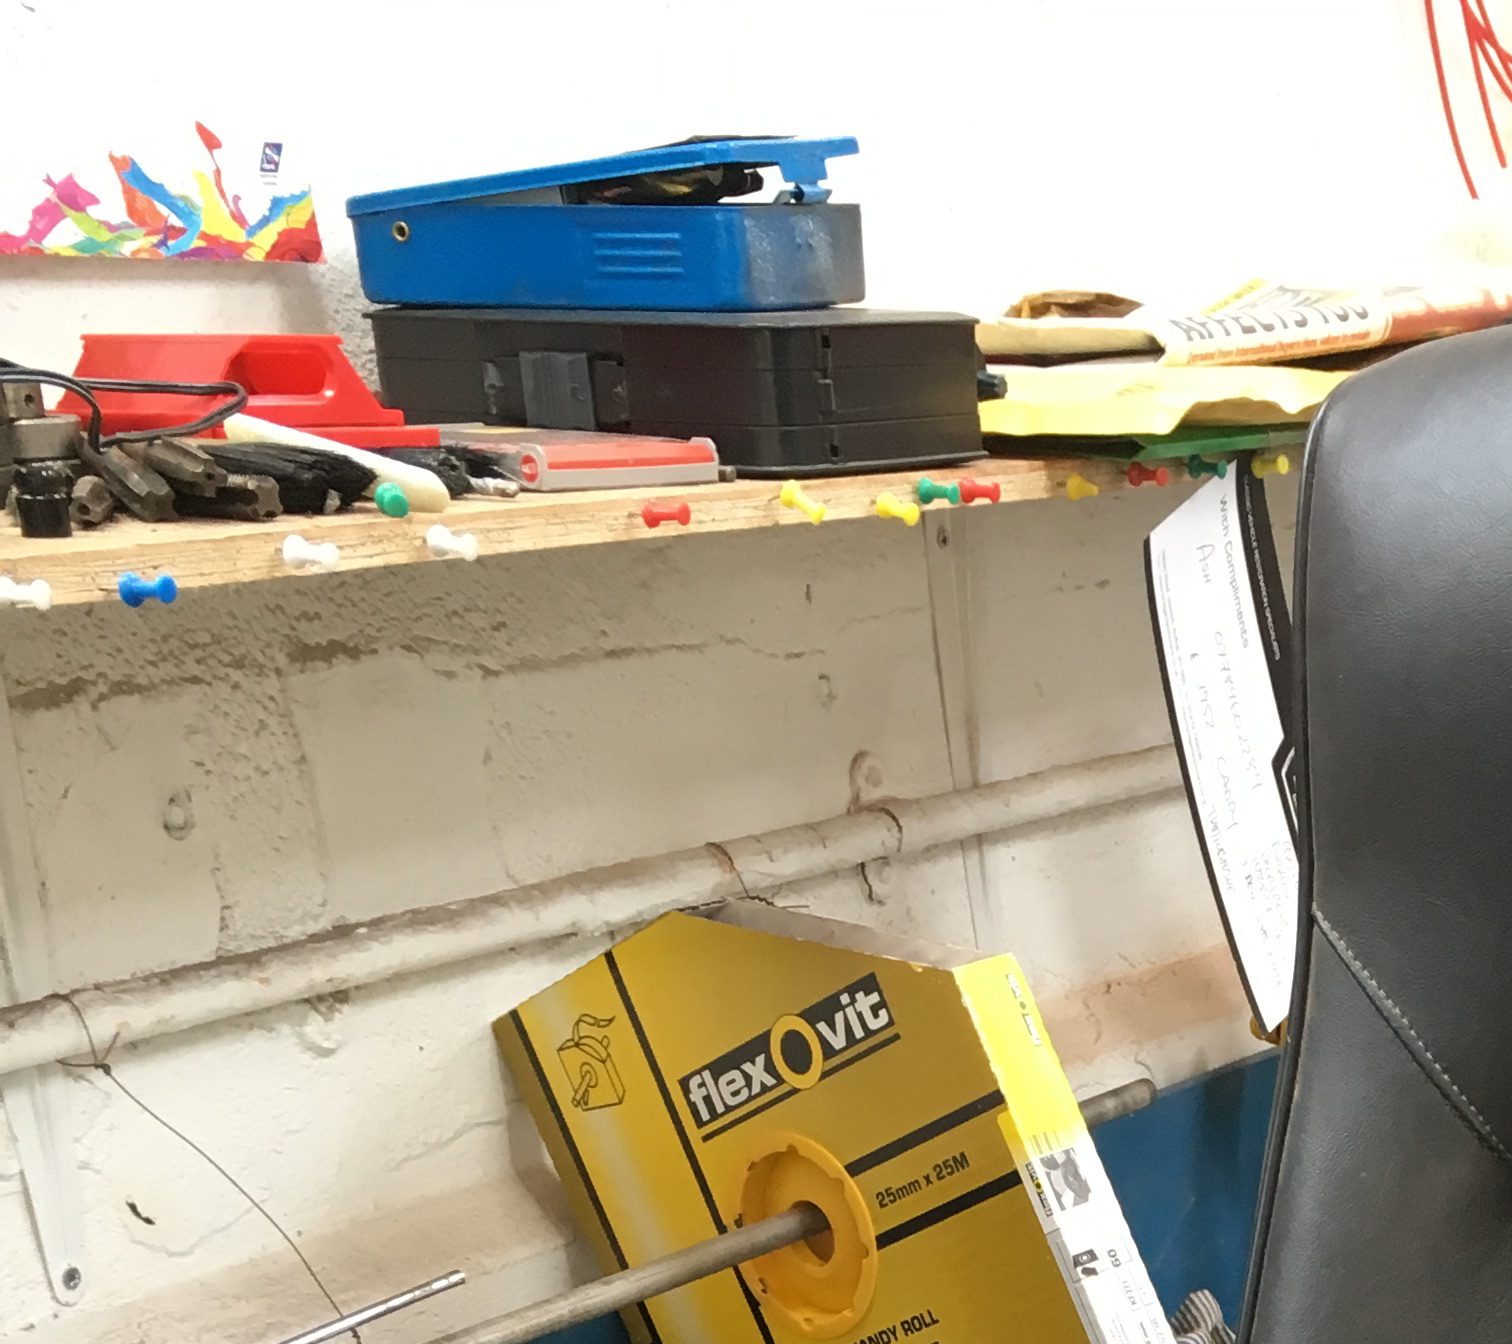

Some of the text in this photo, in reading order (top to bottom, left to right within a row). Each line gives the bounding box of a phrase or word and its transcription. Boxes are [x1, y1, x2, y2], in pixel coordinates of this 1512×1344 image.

[1219, 493, 1249, 649] With Compliments
[875, 1150, 970, 1209] 25mm x 25M
[901, 1309, 940, 1336] ROLL
